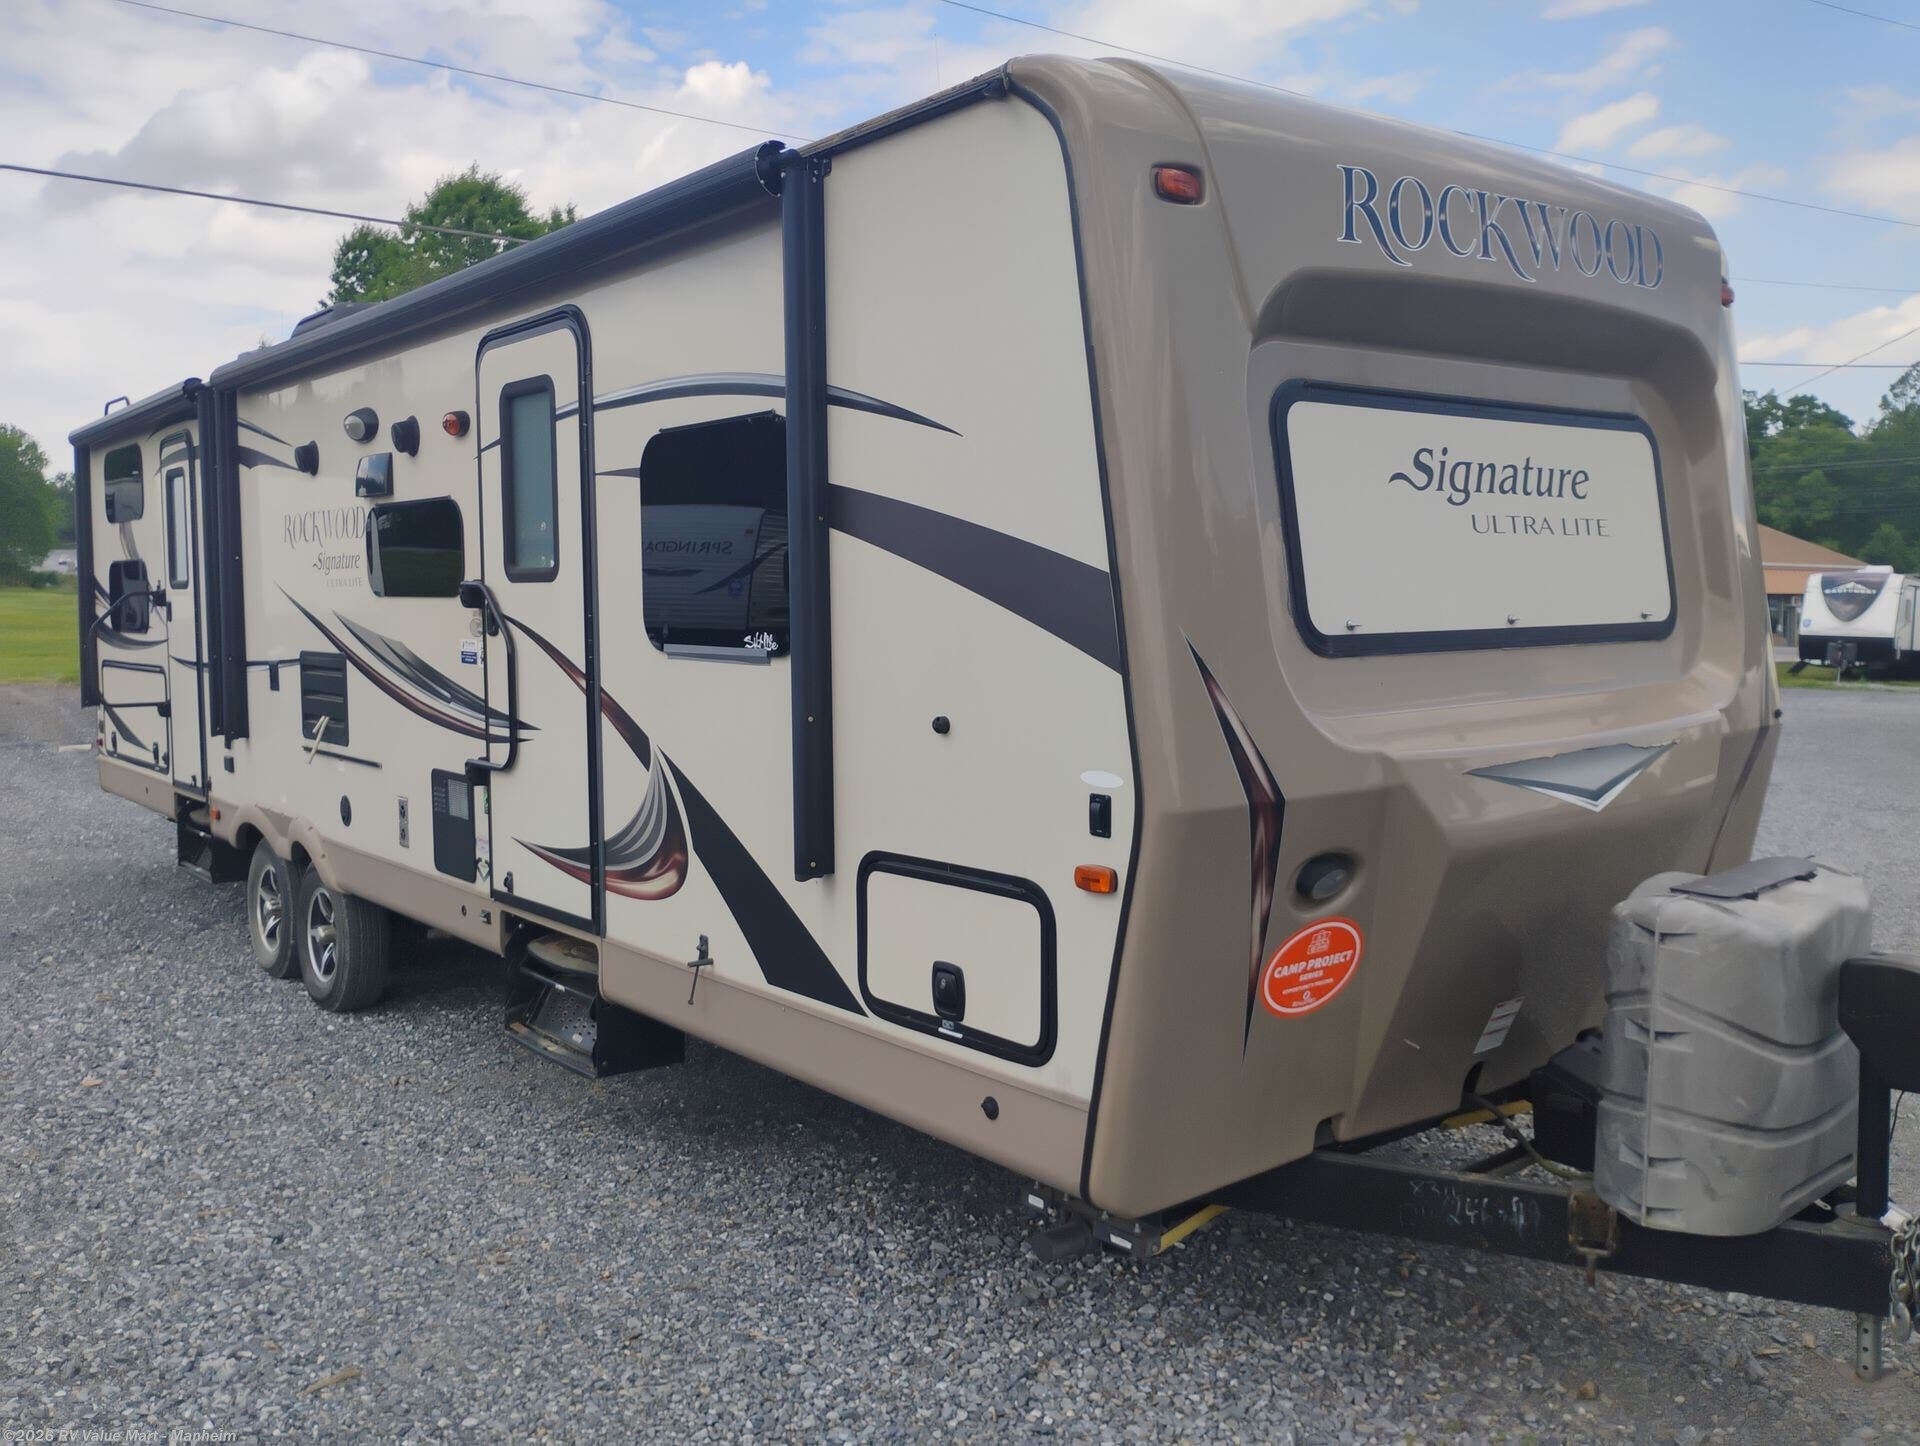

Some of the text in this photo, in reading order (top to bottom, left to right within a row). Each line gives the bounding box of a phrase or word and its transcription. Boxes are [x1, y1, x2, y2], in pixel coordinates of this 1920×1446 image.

[1336, 164, 1665, 291] ROCKWOOD
[1388, 446, 1590, 506] Signature
[283, 506, 366, 549] ROCKWOOD
[1471, 513, 1611, 538] ULTRA LITE
[312, 552, 360, 575] Signature
[1274, 950, 1353, 978] CAMP PROJECT
